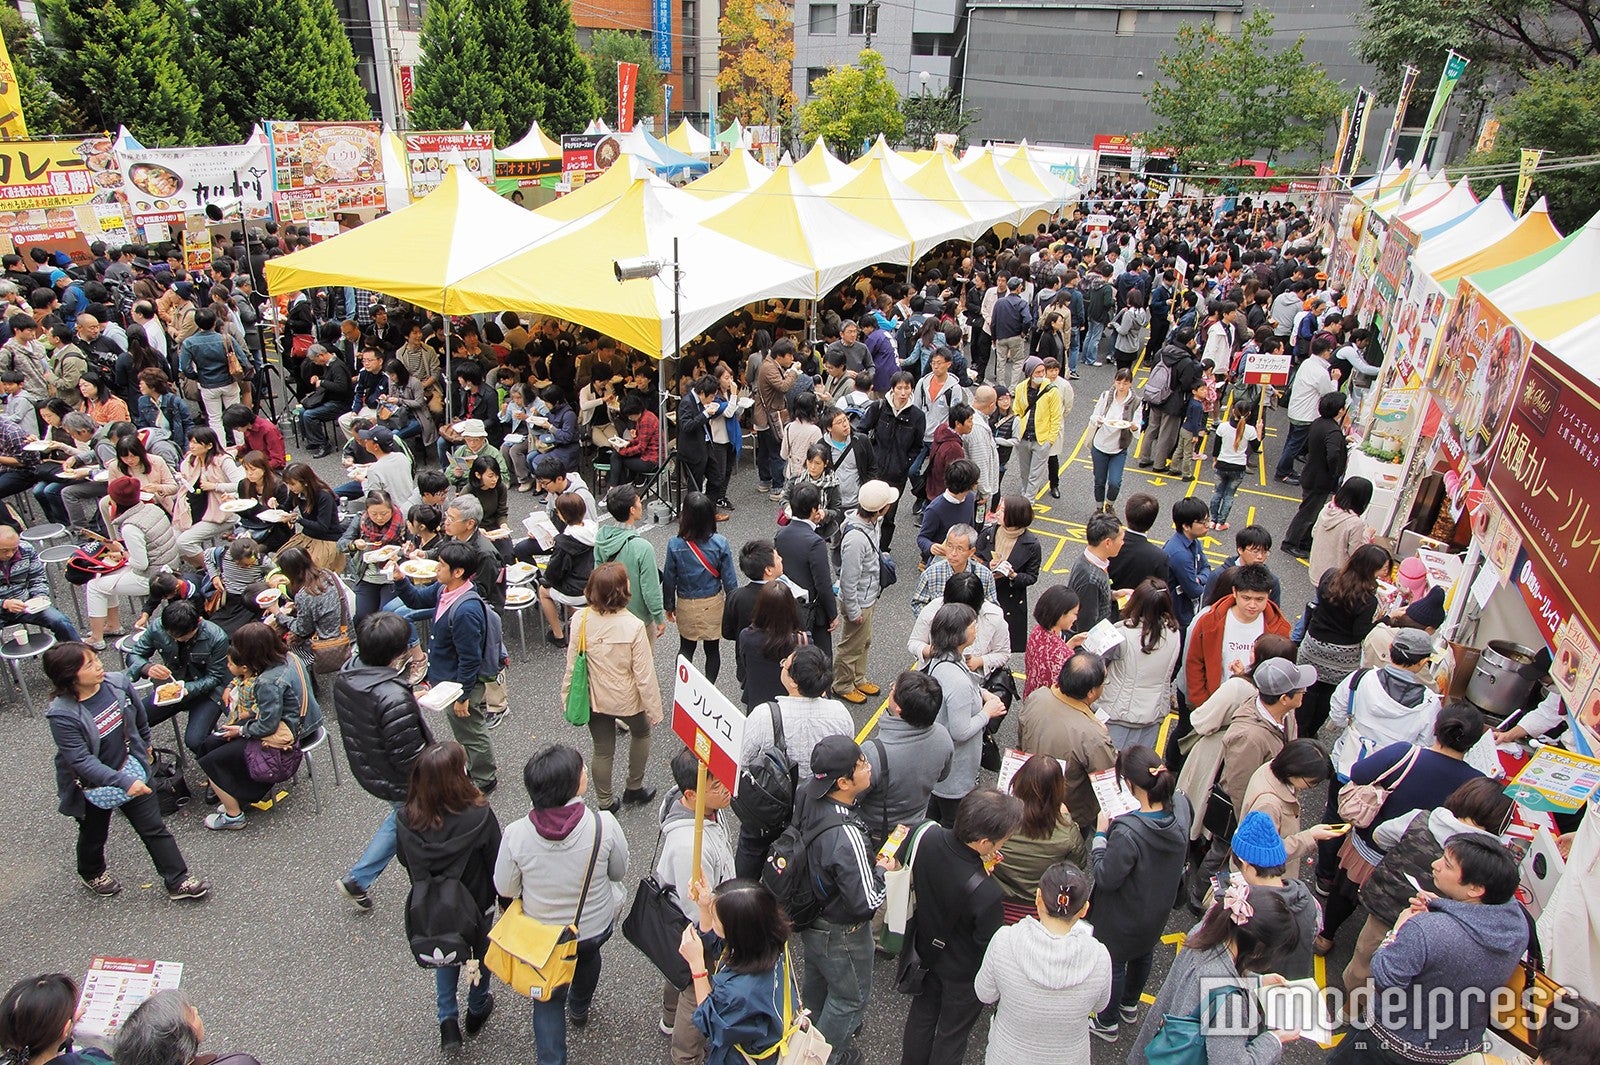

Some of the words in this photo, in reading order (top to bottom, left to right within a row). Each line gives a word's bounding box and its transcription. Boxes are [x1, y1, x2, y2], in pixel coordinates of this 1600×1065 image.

[465, 134, 491, 147] サモサ
[508, 162, 550, 175] オオドリー
[693, 688, 733, 742] ソレイユ
